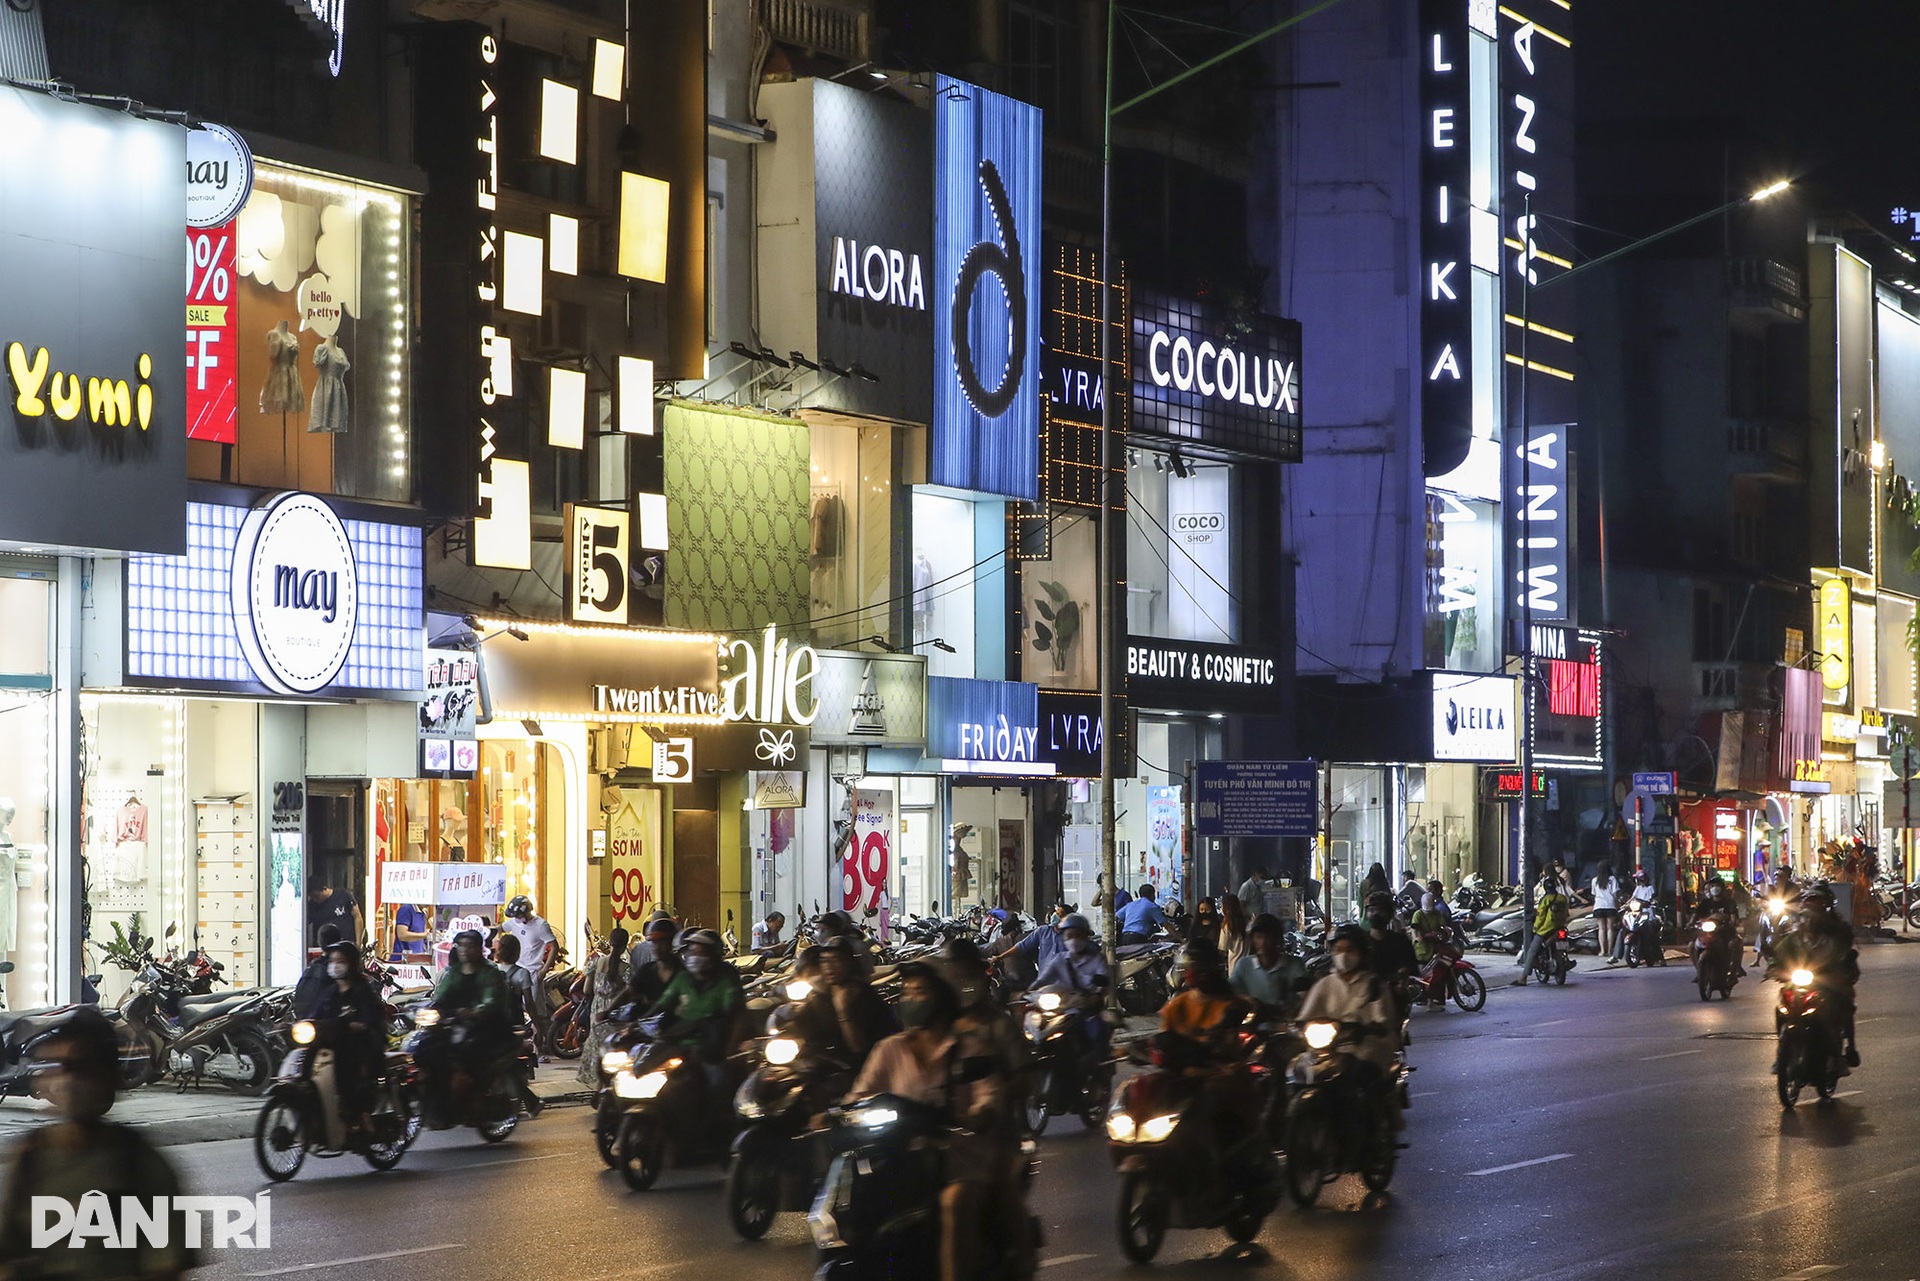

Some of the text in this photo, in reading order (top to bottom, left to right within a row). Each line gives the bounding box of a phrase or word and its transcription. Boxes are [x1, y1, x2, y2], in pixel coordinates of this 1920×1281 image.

[1429, 33, 1461, 381] LEIKA
[832, 236, 926, 310] ALORA
[307, 306, 334, 320] pretty
[310, 290, 332, 303] hello
[188, 309, 210, 323] SALE
[8, 341, 153, 431] Yumi
[1148, 330, 1296, 414] COCOLUX
[1177, 515, 1220, 530] COCO
[1186, 534, 1211, 544] SHOP
[1516, 431, 1558, 613] MINA
[592, 523, 625, 613] 5
[274, 564, 337, 624] may
[286, 636, 321, 648] BOUTIQUE
[1531, 624, 1567, 660] MINA
[1825, 586, 1843, 682] ZAMY
[1127, 646, 1275, 685] BEAUTY & COSMETIC
[593, 684, 719, 715] Twenty.Five
[1051, 713, 1103, 755] LYRA
[1461, 706, 1505, 731] LEIKA
[666, 743, 690, 779] 5
[765, 785, 794, 795] ALORA
[1204, 777, 1311, 790] TUYẾN PHỐ VĂN MINH ĐÔ THỊ
[612, 839, 628, 857] SƠ
[630, 839, 642, 856] MI
[441, 872, 483, 892] TRÀ DÂU
[843, 831, 888, 913] 89
[612, 867, 652, 921] 99 K
[455, 921, 483, 932] 100%
